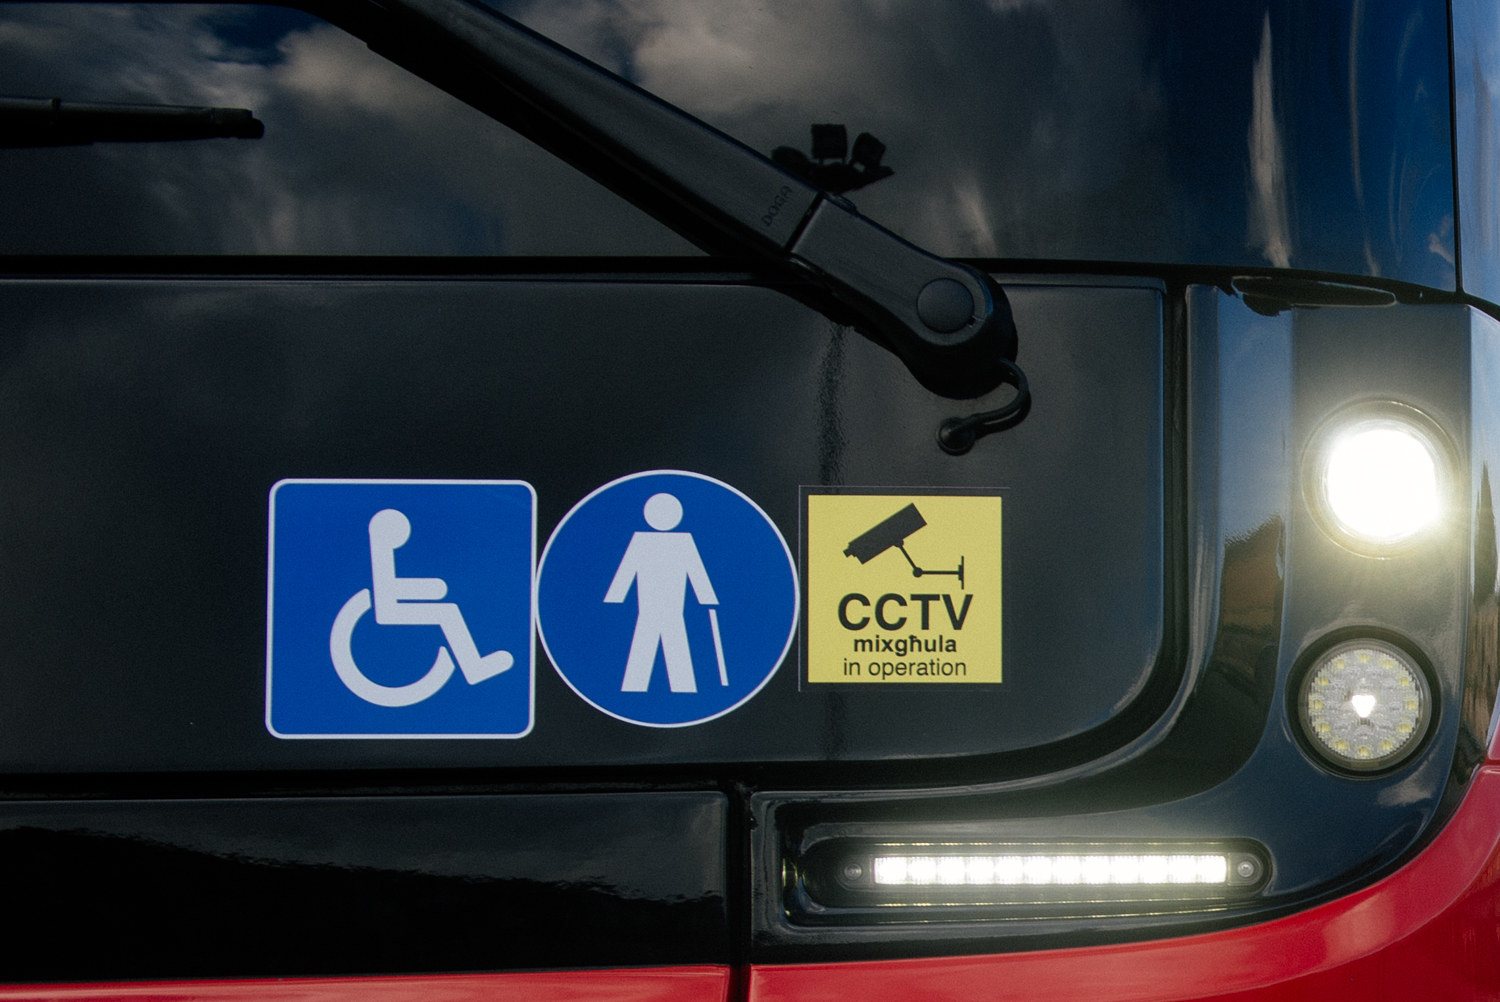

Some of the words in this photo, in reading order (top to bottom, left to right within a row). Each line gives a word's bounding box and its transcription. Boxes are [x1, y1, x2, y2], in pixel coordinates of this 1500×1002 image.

[761, 185, 792, 227] DOGA
[837, 592, 974, 631] CCTV
[853, 634, 957, 657] mixgħula
[843, 657, 861, 676] in
[868, 658, 967, 680] operation
